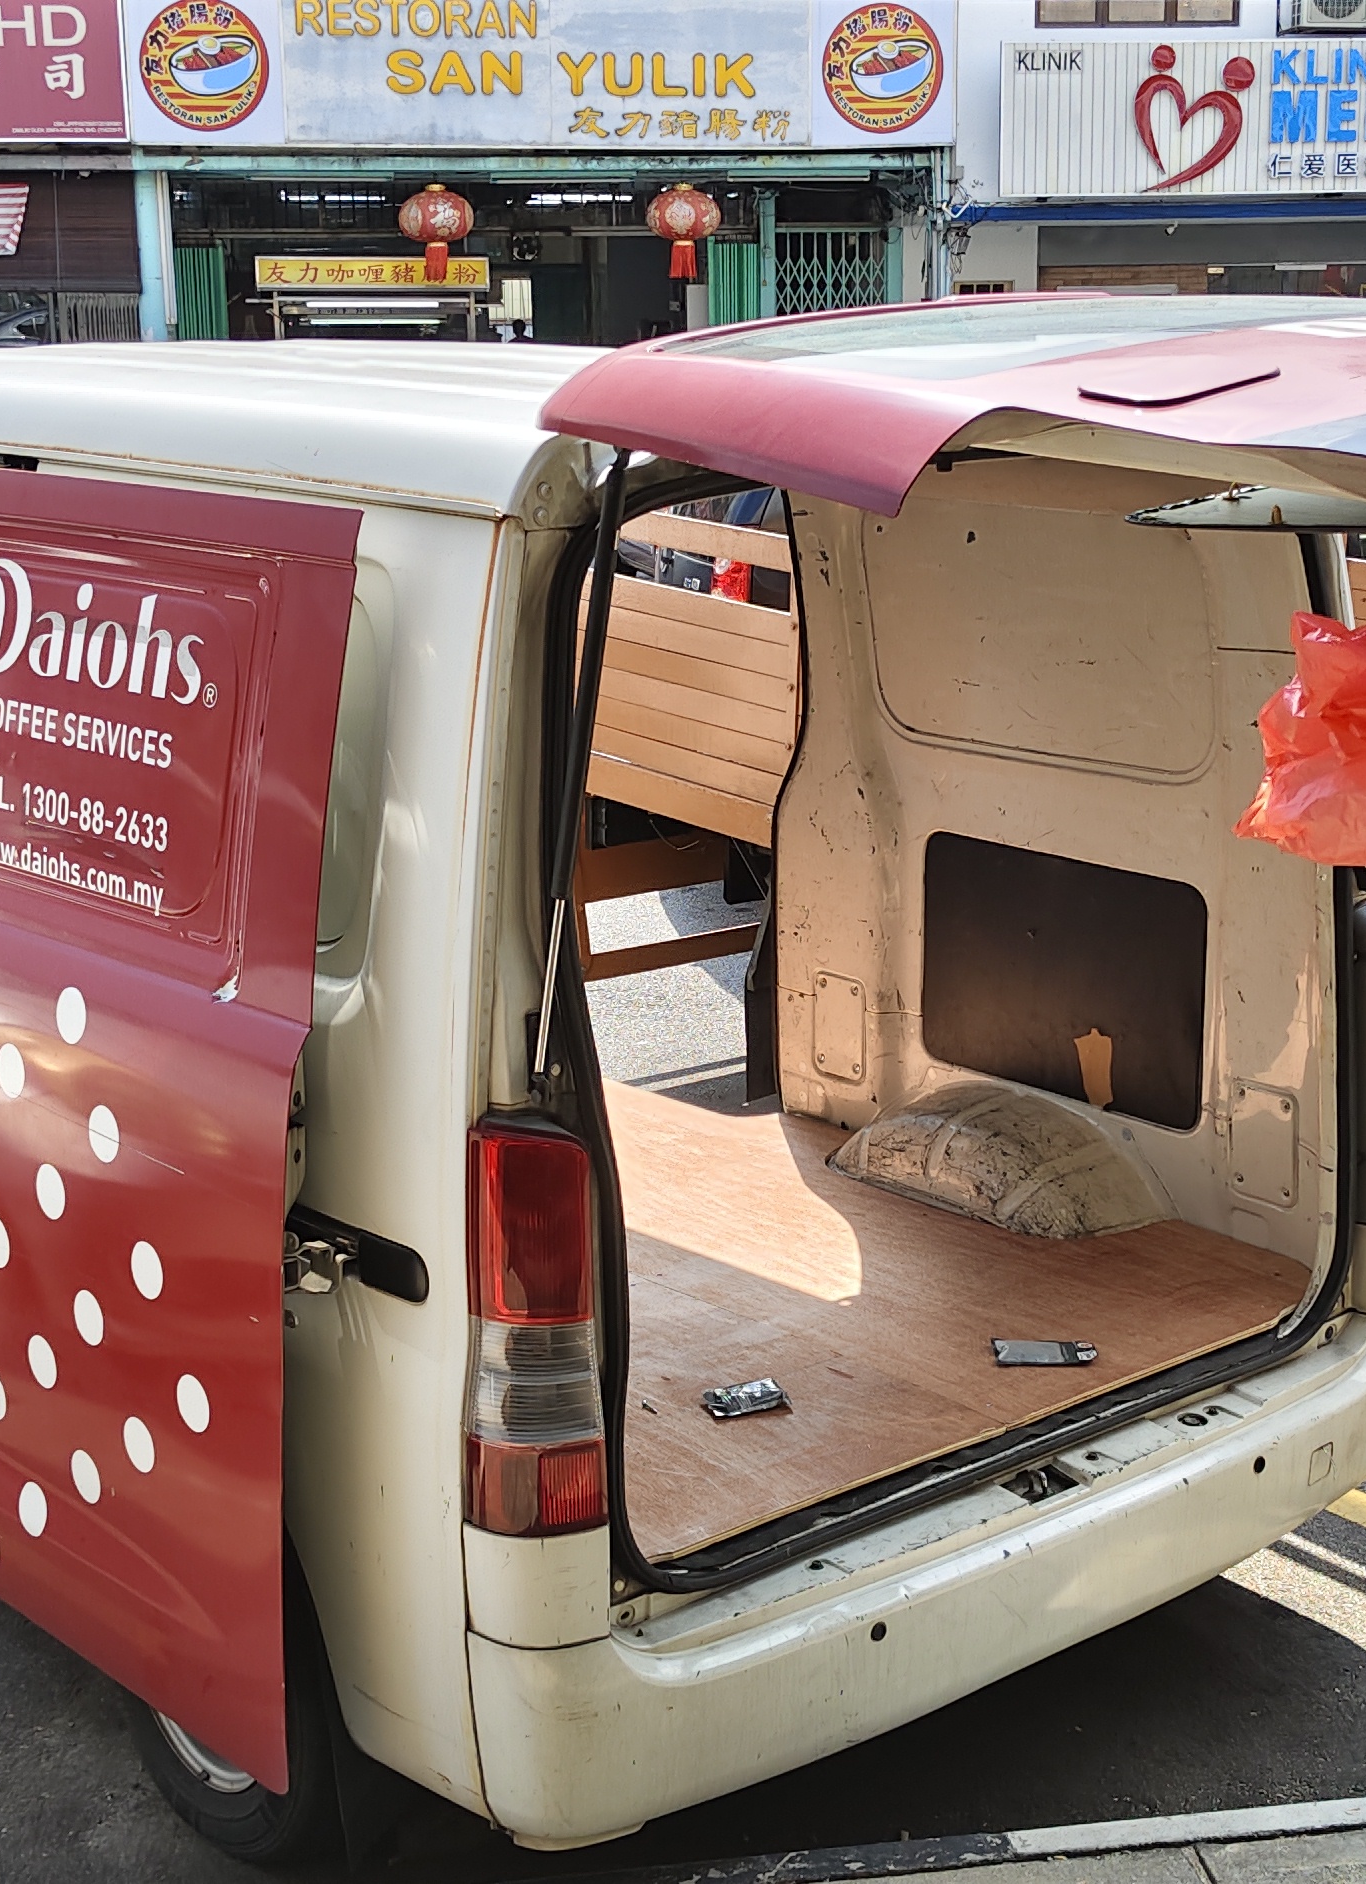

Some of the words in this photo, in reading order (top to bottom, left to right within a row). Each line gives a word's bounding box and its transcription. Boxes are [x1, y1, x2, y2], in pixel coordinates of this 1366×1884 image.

[295, 0, 536, 38] RESTORAN
[386, 50, 523, 96] SAN
[556, 52, 756, 98] YULIK
[1016, 51, 1082, 72] KLINIK
[153, 85, 202, 124] RESTORAN
[206, 114, 228, 125] SAN
[229, 89, 255, 116] YULIK
[833, 90, 879, 127] RESTORAN
[882, 115, 903, 127] SAN
[905, 91, 930, 117] YULIK
[61, 712, 173, 769] SERVICES
[22, 782, 168, 852] 1300-88-2633
